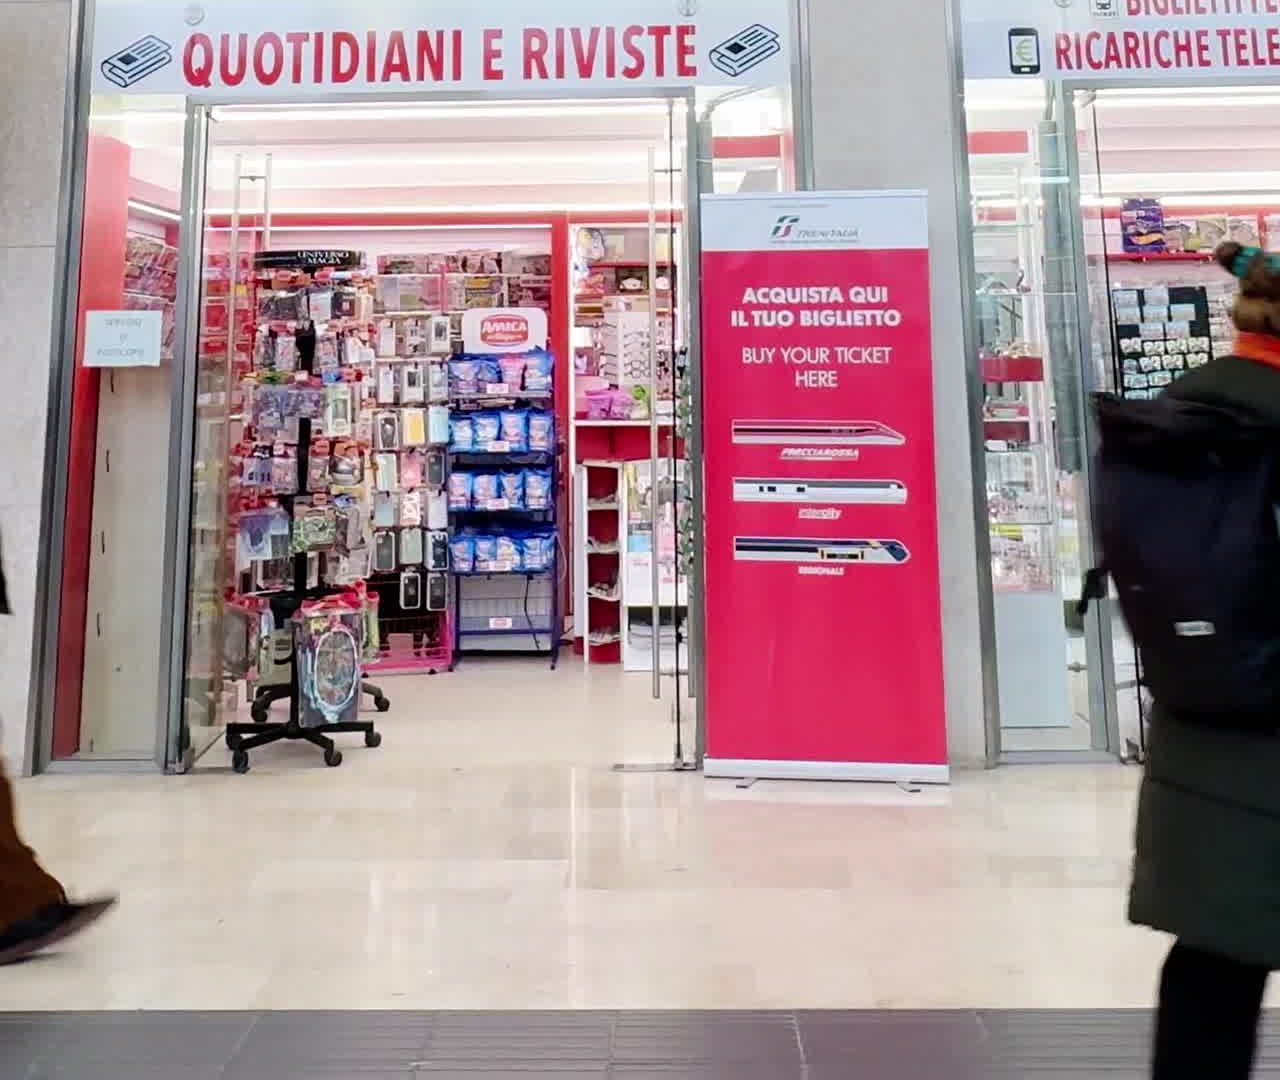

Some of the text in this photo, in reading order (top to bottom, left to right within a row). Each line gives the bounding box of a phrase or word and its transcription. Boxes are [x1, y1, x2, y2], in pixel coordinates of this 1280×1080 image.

[181, 23, 698, 87] QUOTIDIANI E RIVISTE
[1055, 29, 1212, 71] RICARICHE
[742, 286, 889, 304] ACQUISTA QUI
[730, 308, 902, 327] IL TUO BIGLIETTO
[742, 346, 893, 364] BUY YOUR TICKET
[795, 370, 838, 388] HERE
